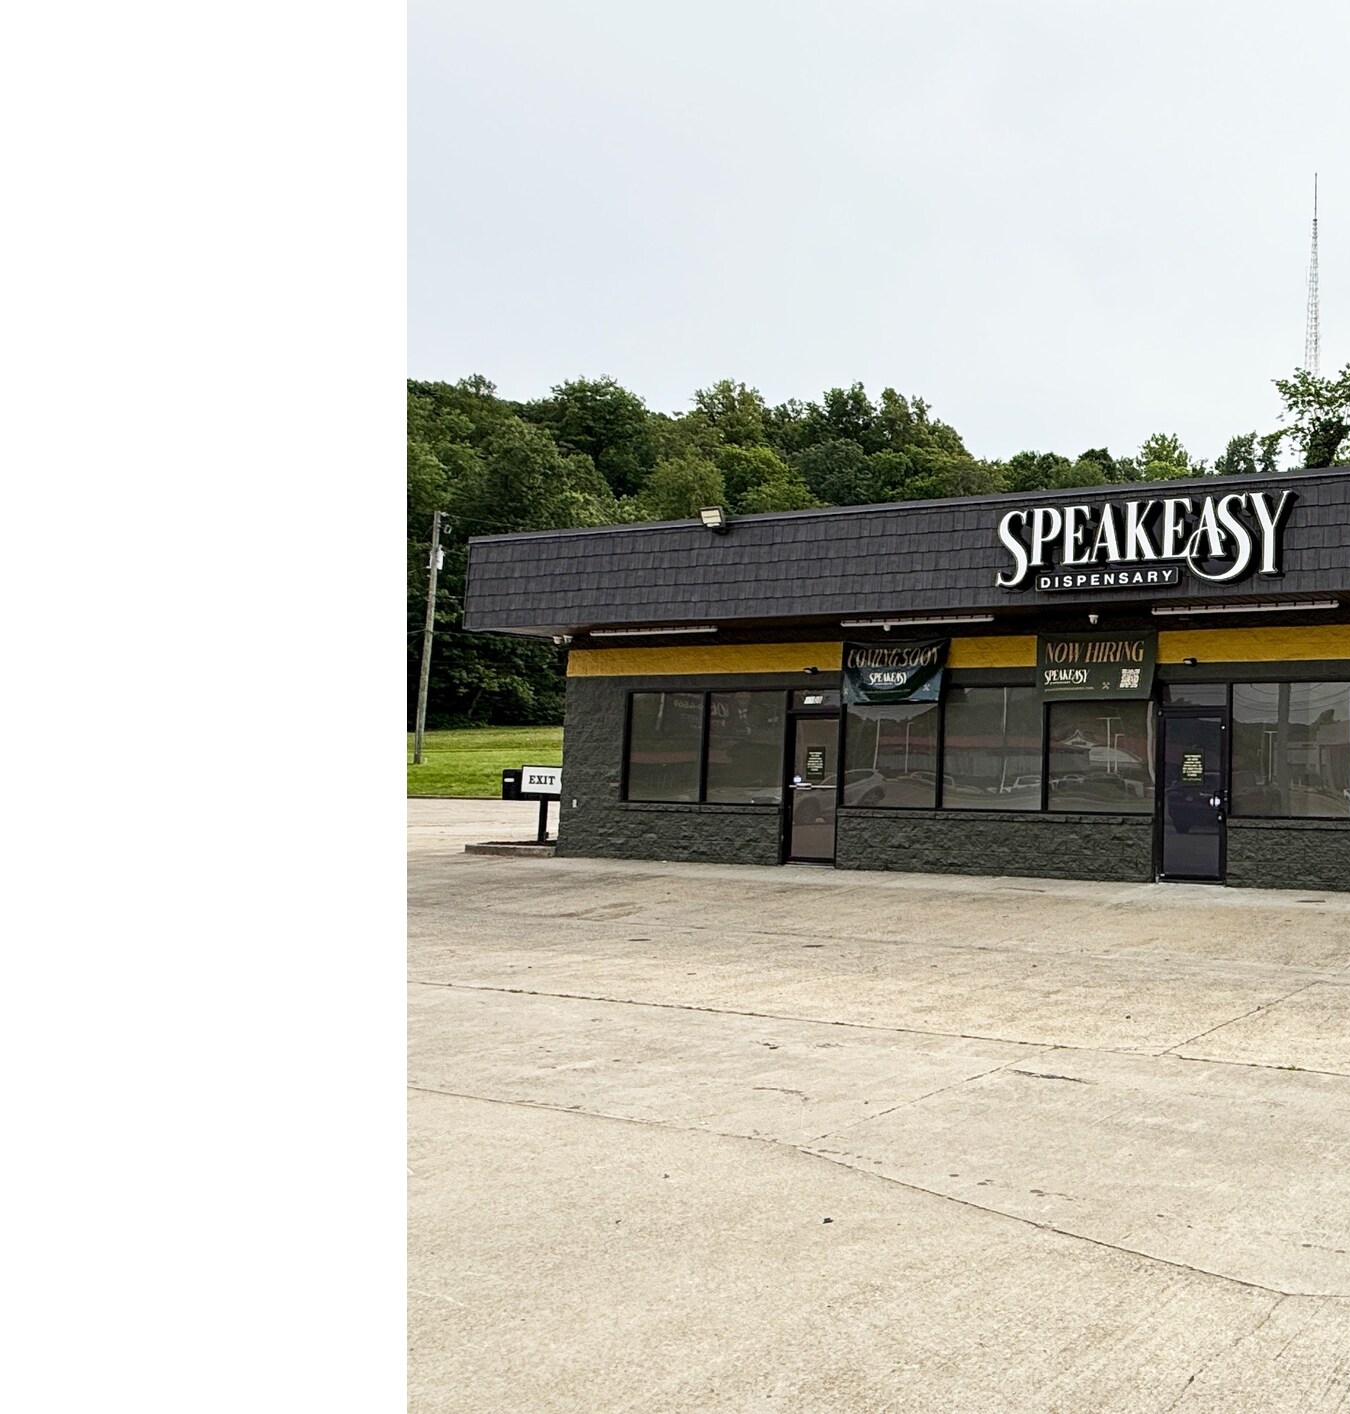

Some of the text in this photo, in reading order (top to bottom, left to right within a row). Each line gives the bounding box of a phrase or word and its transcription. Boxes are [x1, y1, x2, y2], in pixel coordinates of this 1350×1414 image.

[995, 489, 1293, 588] SPEAKEASY
[1039, 569, 1174, 590] DISPENSARY
[847, 647, 901, 668] COMING
[1045, 640, 1145, 664] NOW HIRING
[1044, 668, 1090, 686] SPEAKEASY
[528, 775, 556, 785] EXIT
